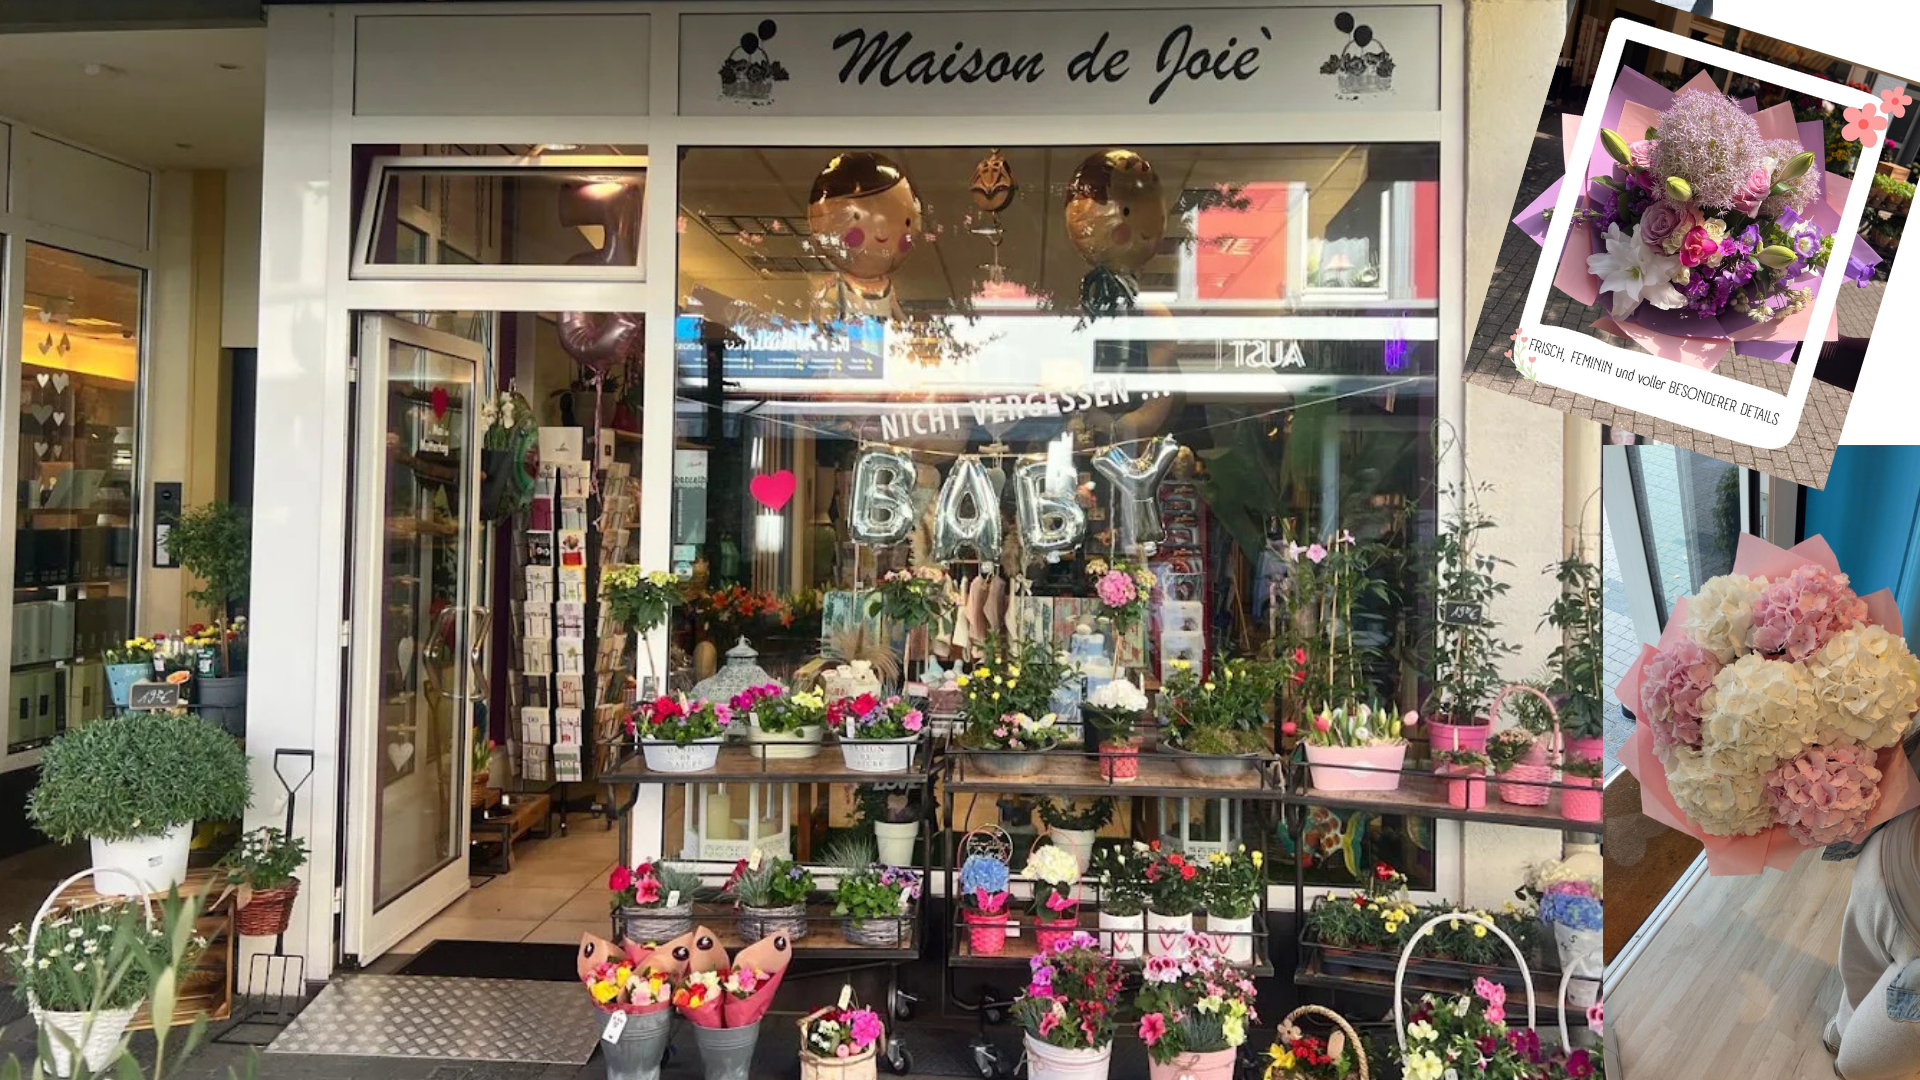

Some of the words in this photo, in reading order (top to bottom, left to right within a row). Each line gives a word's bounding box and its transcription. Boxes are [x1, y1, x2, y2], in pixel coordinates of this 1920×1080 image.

[833, 28, 1044, 87] Maison
[1067, 32, 1129, 83] de
[880, 409, 962, 441] NICHT
[969, 378, 1130, 426] VERGESSEN
[849, 435, 1179, 562] BABY
